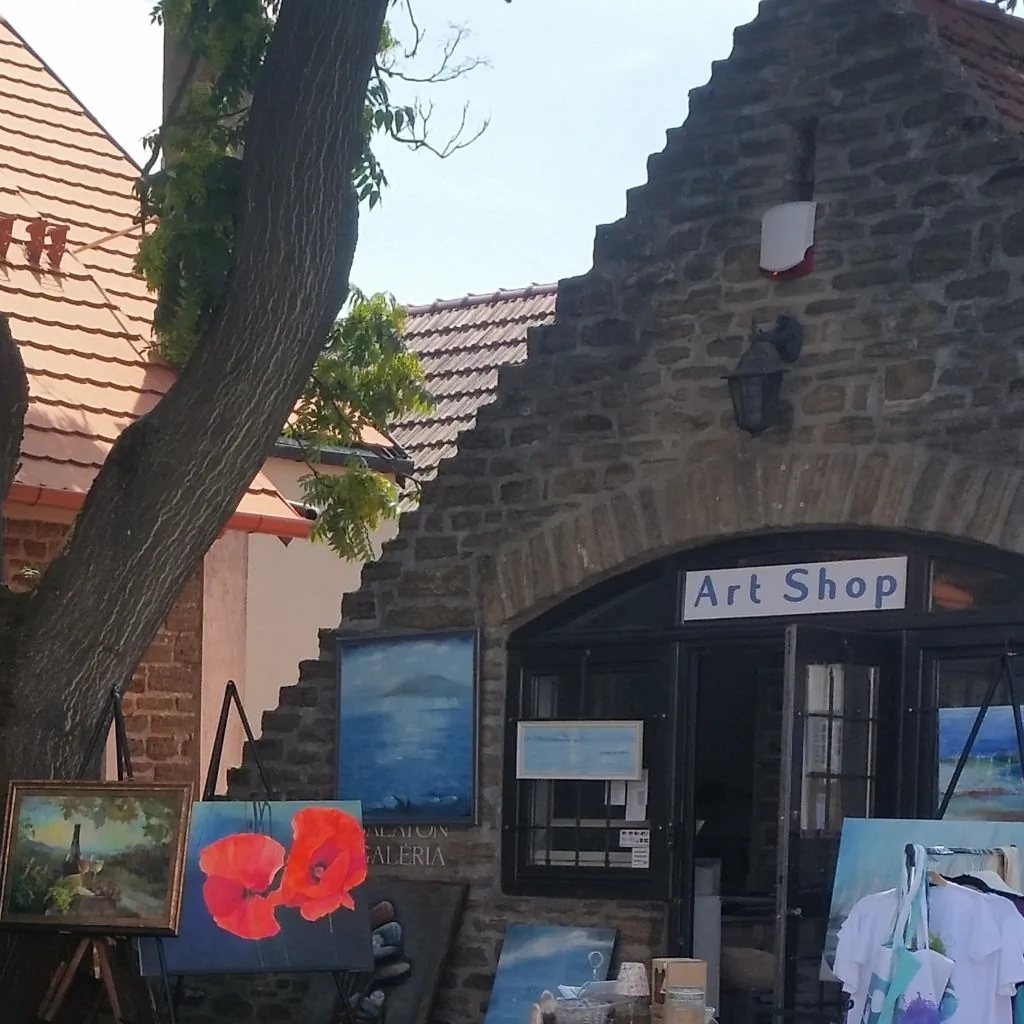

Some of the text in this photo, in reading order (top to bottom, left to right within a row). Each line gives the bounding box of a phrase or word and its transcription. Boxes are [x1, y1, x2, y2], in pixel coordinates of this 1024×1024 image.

[694, 567, 897, 609] Art Shop
[364, 825, 449, 838] ALATON
